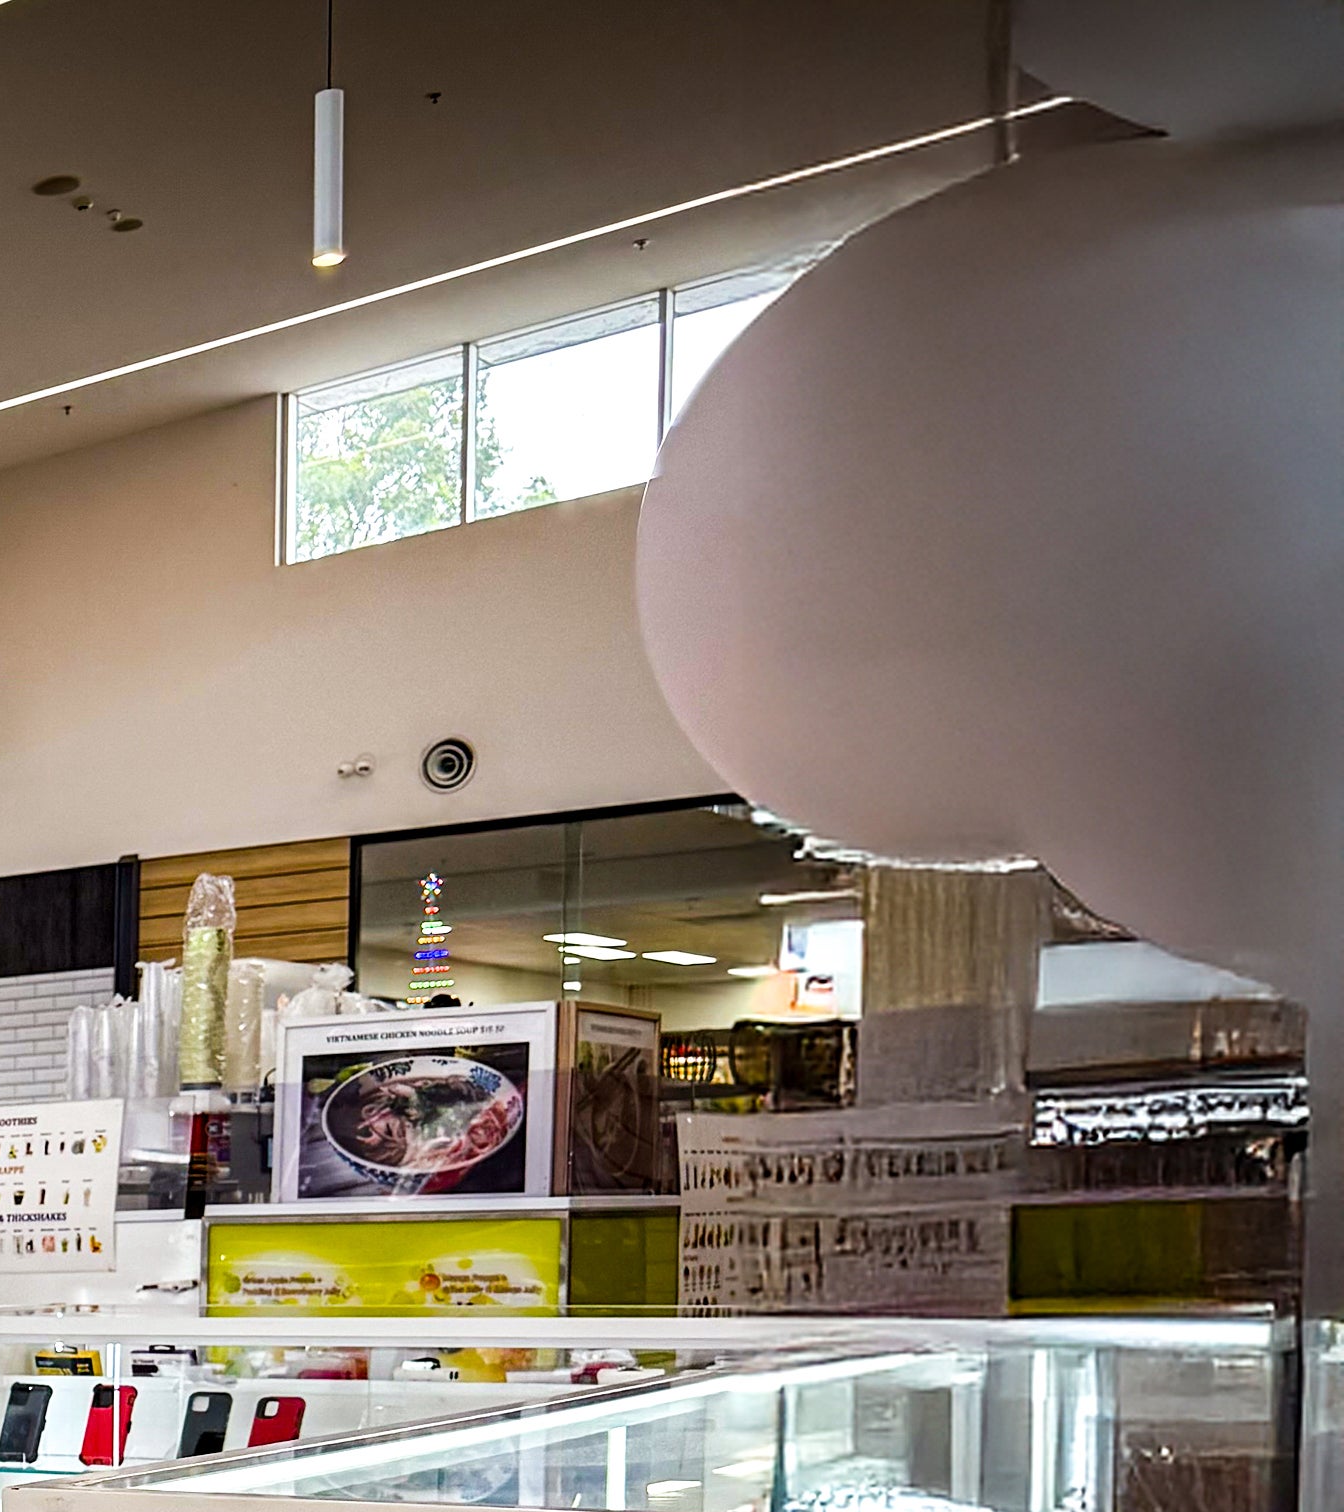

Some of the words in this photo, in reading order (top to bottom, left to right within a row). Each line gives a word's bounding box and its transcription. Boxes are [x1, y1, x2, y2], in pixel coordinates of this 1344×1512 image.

[326, 1031, 378, 1043] VIETNAMESE
[380, 1030, 417, 1040] CHICKEN
[6, 1212, 67, 1223] THICKSHAKES
